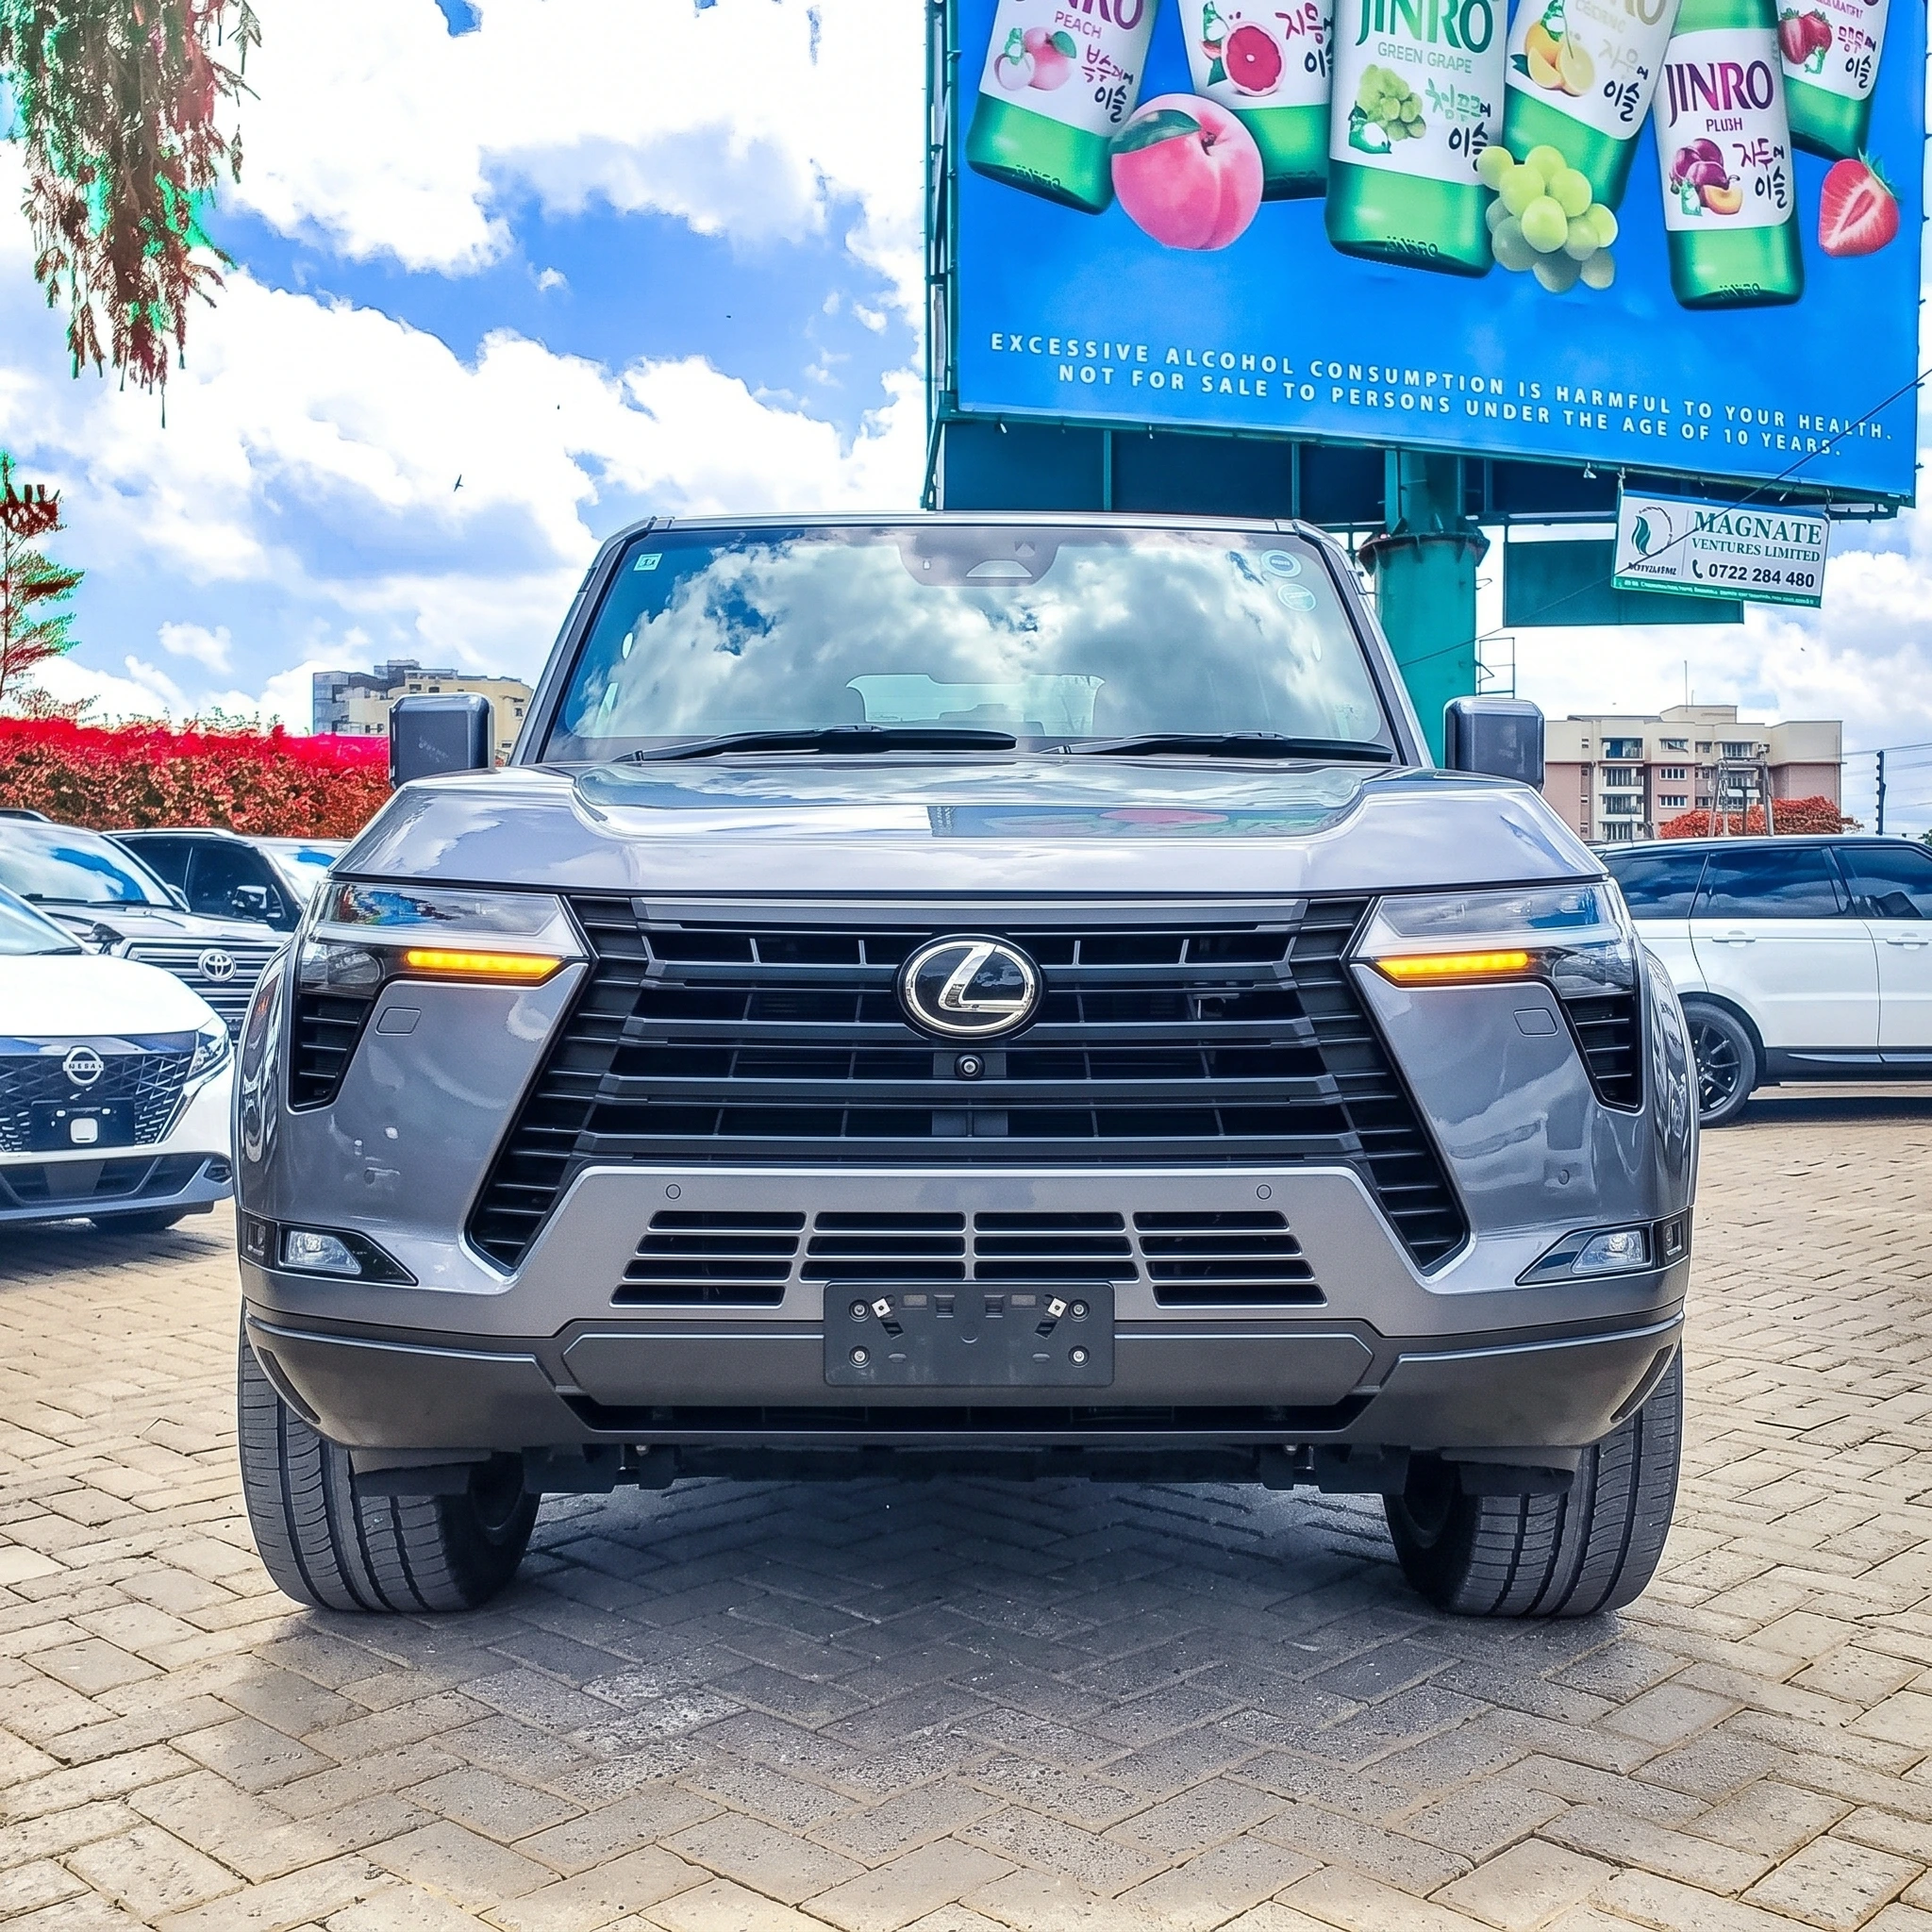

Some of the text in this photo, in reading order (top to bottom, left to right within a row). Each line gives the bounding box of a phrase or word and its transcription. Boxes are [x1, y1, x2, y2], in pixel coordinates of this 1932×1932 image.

[1054, 10, 1103, 40] PEACH
[1377, 42, 1473, 75] GREEN GRAPE
[1664, 59, 1774, 128] JINRO
[991, 333, 1892, 441] EXCESSIVE ALCOHOL CONSUMPTION IS HARMFUL TO YOUR HEALTH.
[1059, 364, 1841, 457] NOT FOR SALE TO PERSONS UNDER THE AGE OF 10 YEARS.
[1694, 510, 1823, 545] MAGNATE
[1691, 538, 1821, 562] VENTURES LIMITED
[1707, 563, 1815, 588] 0722 284 480
